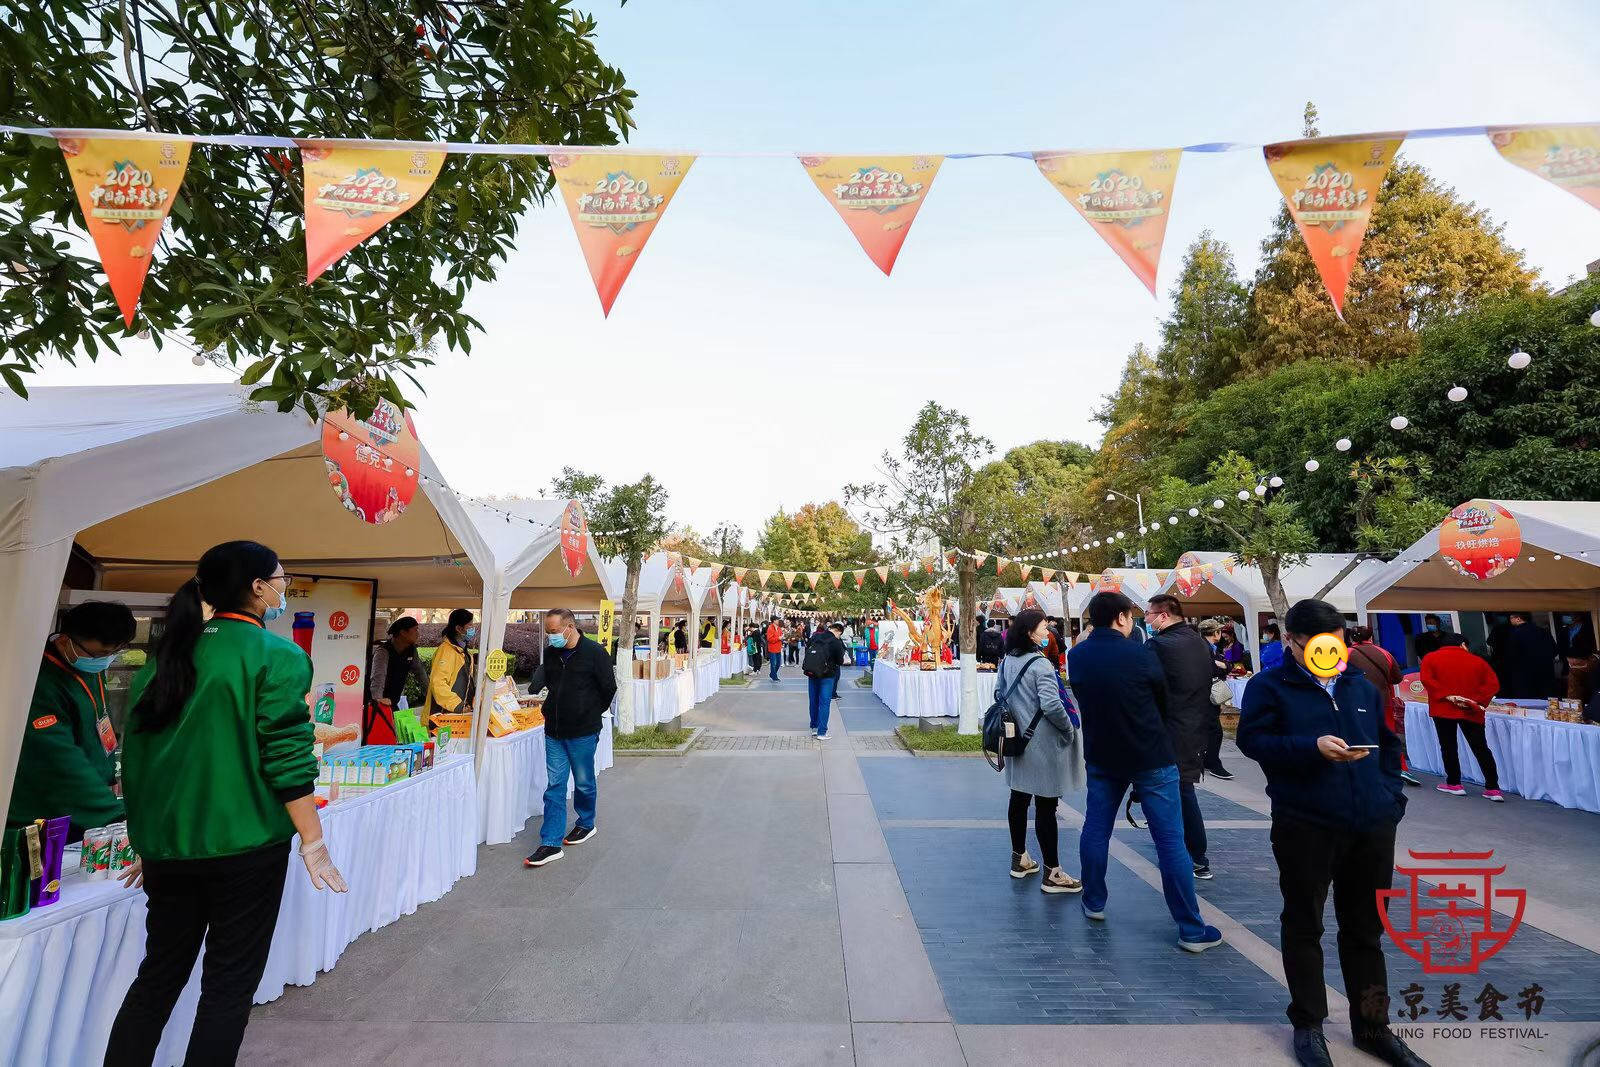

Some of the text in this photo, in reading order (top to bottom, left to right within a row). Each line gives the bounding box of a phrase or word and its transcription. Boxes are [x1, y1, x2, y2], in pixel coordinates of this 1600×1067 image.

[105, 168, 153, 187] 2020
[344, 175, 397, 190] 2020
[848, 170, 905, 184] 2020
[1089, 175, 1143, 193] 2020
[1305, 171, 1354, 190] 2020
[594, 179, 649, 194] 2020
[1462, 509, 1487, 519] 2020
[342, 669, 357, 682] 30
